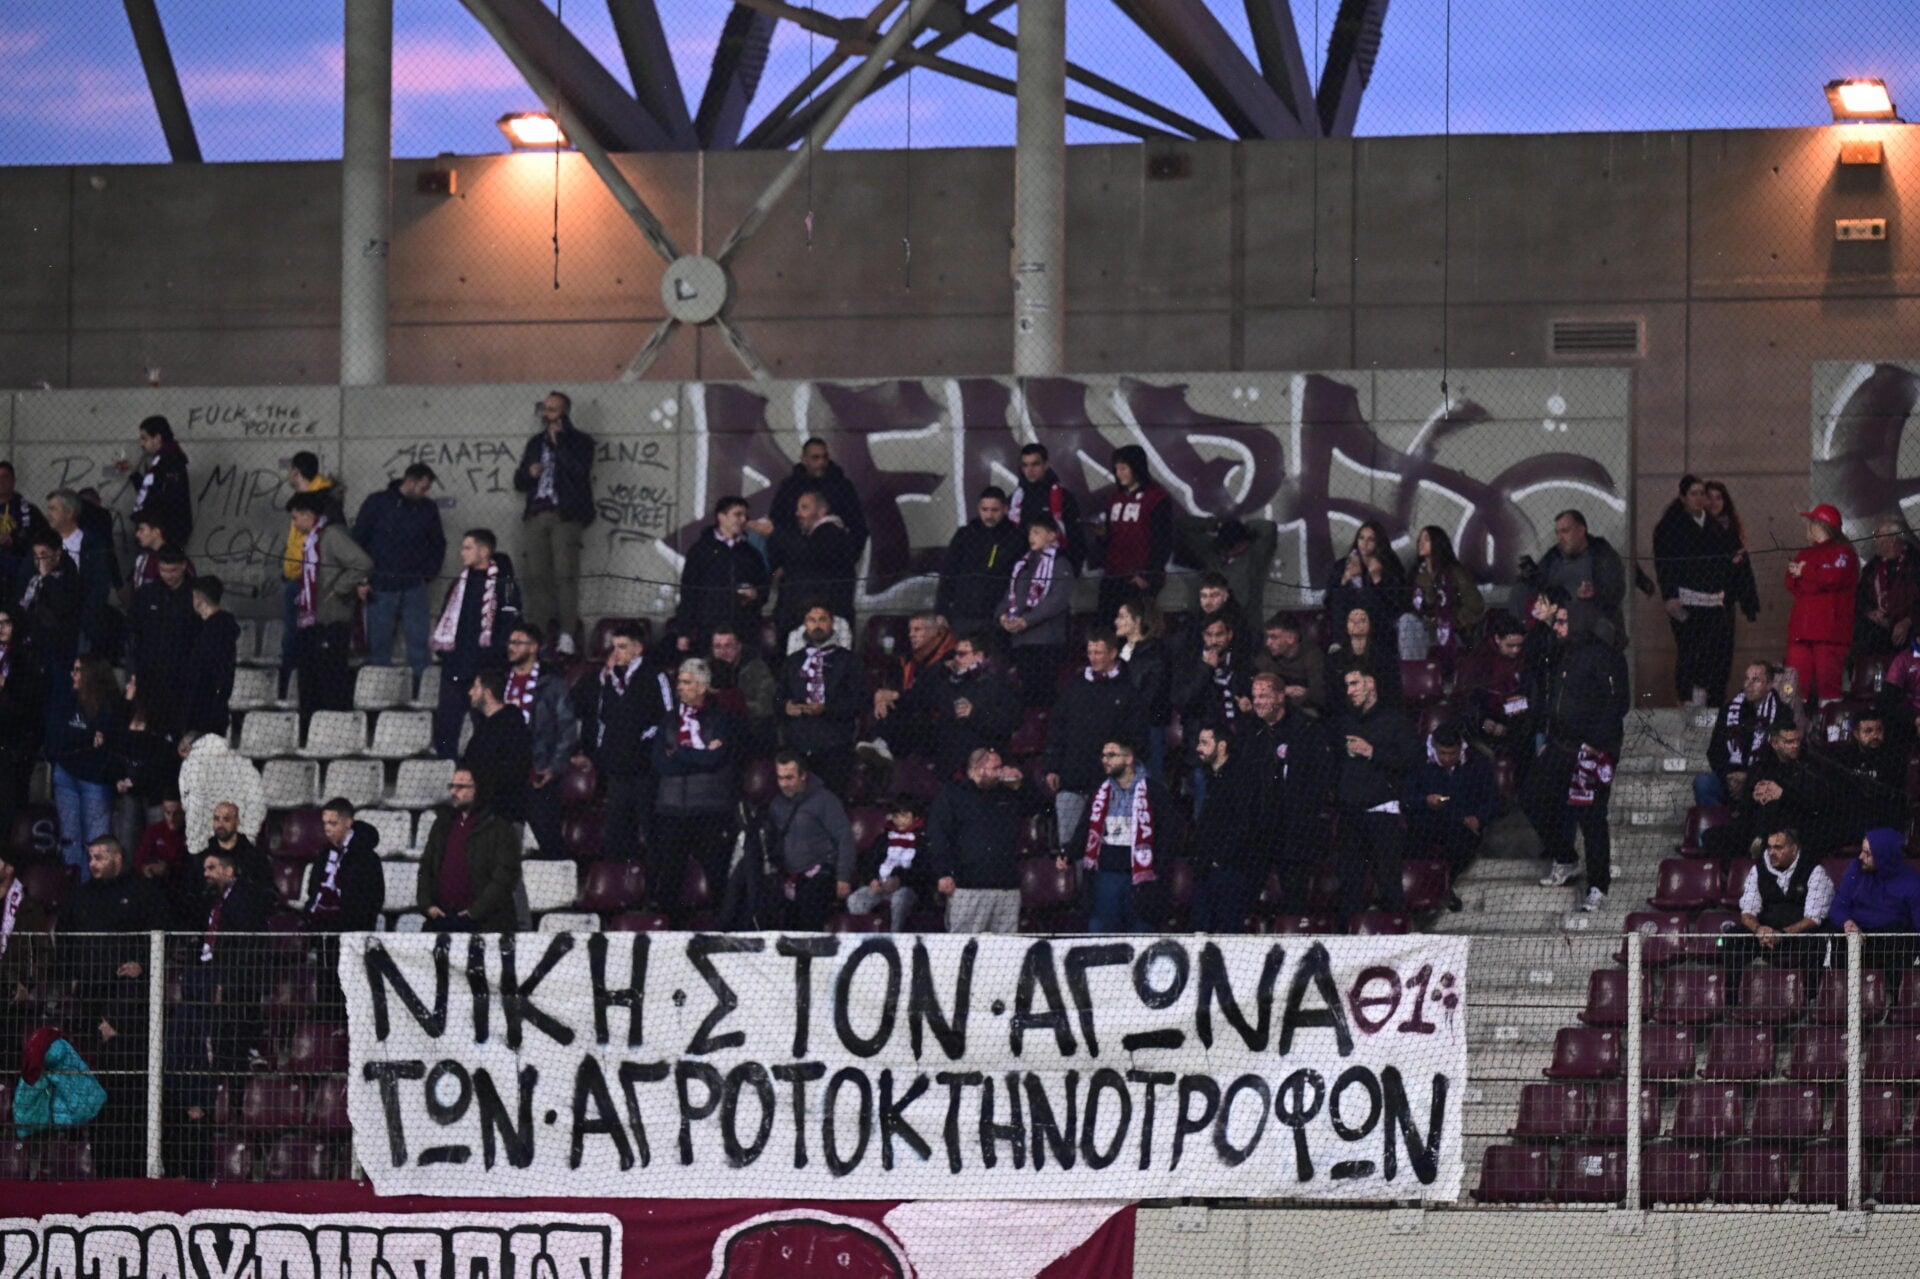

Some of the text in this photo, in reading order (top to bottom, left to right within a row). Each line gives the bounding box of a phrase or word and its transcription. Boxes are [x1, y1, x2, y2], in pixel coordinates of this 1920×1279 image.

[188, 404, 249, 430] FUCK
[242, 420, 319, 436] POLICE
[597, 499, 678, 536] STREET
